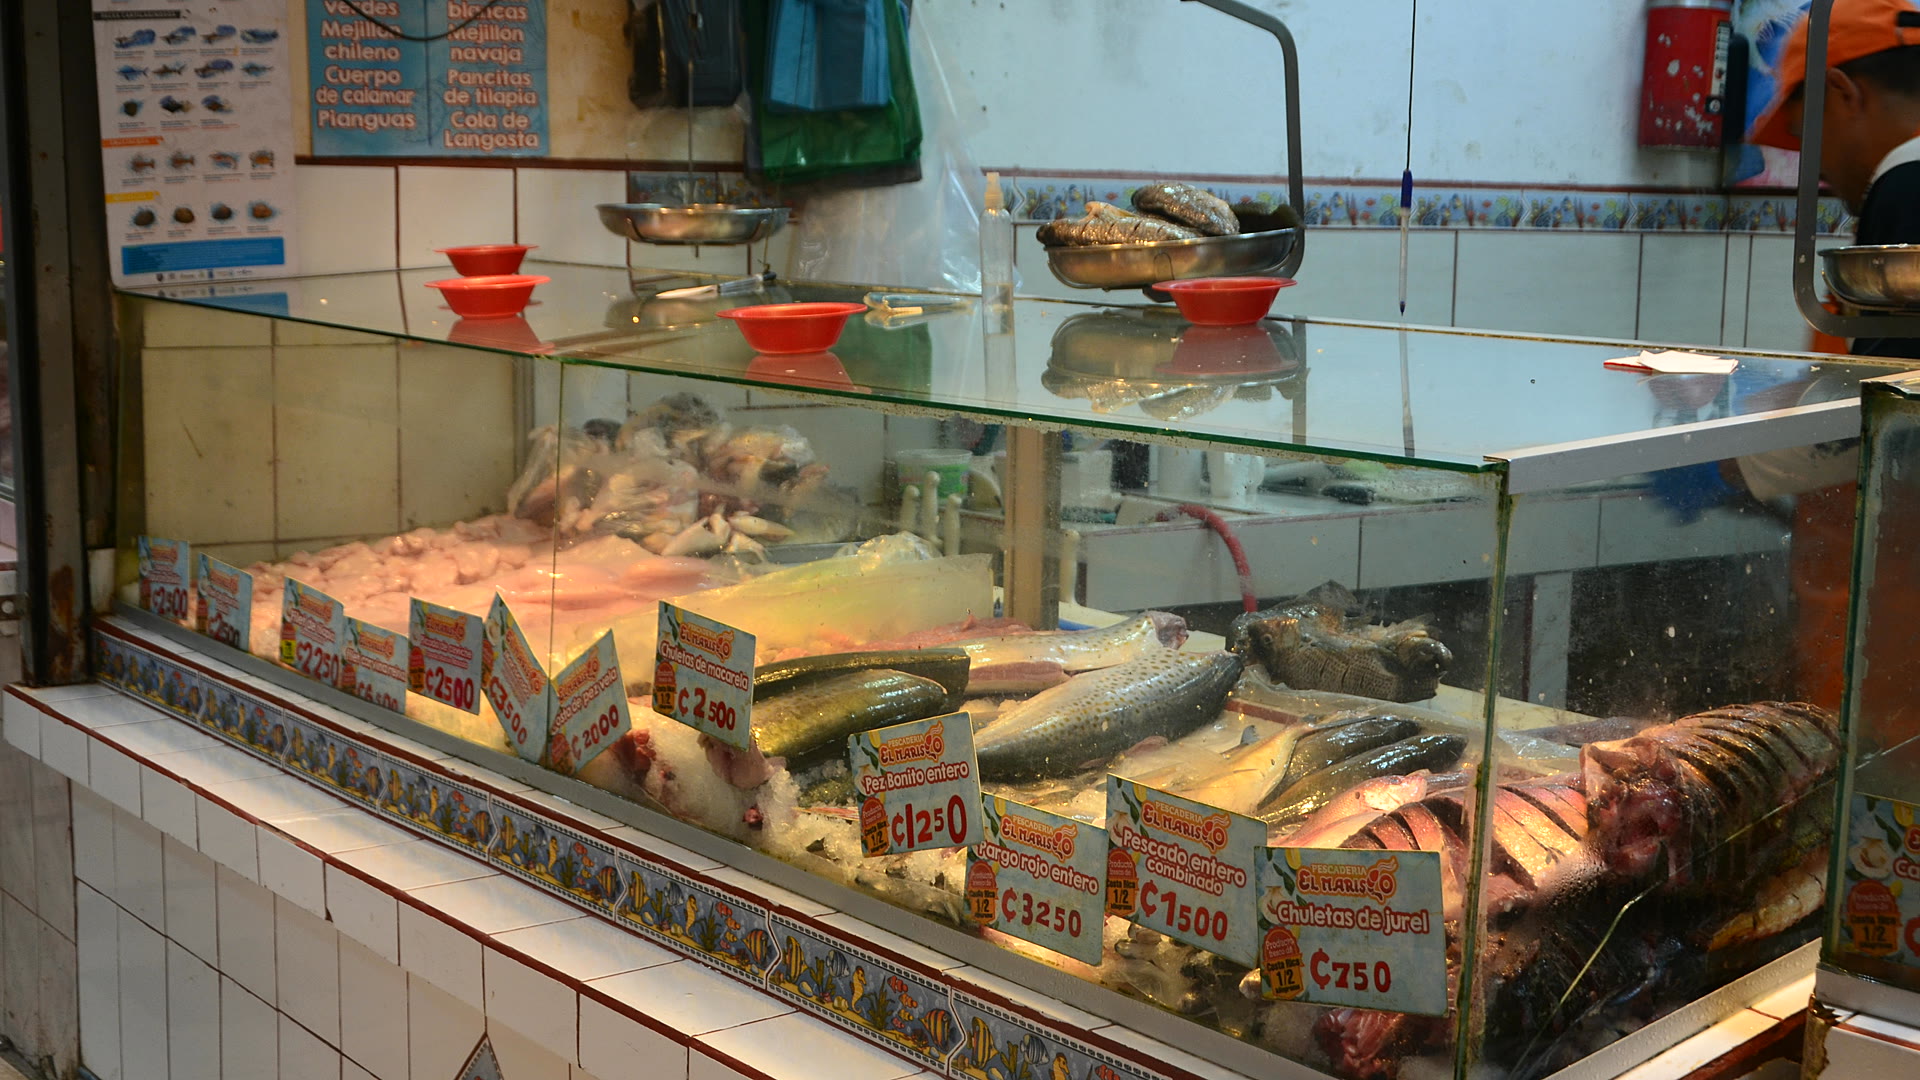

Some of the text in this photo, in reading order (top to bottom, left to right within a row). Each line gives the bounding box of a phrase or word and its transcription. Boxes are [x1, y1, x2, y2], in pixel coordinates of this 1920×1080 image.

[324, 41, 401, 60] chileno
[450, 44, 522, 64] navaja
[325, 66, 401, 88] Cuerpo
[447, 68, 532, 87] Pancitas
[315, 87, 415, 106] de calamar
[443, 88, 538, 108] de tilapia
[317, 110, 416, 132] Pianguas
[451, 110, 529, 129] Cola de
[443, 129, 539, 151] Langosta
[660, 639, 695, 669] Chuletas
[695, 654, 707, 673] de
[706, 662, 749, 692] macarela
[582, 685, 601, 709] pez
[599, 666, 618, 692] vela
[880, 746, 895, 764] EL
[864, 761, 969, 794] Pez Bonito entero
[1142, 803, 1160, 827] EL
[1001, 817, 1016, 839] EL
[978, 841, 1099, 896] Pargo rojo entero
[1122, 827, 1247, 888] Pescado entero
[1146, 856, 1224, 897] combinado
[1298, 868, 1318, 891] EL
[1311, 864, 1367, 876] PESCADERIA
[1113, 889, 1129, 904] 1/2
[1276, 900, 1430, 936] Chuletas de jurel
[1276, 968, 1296, 987] 1/2
